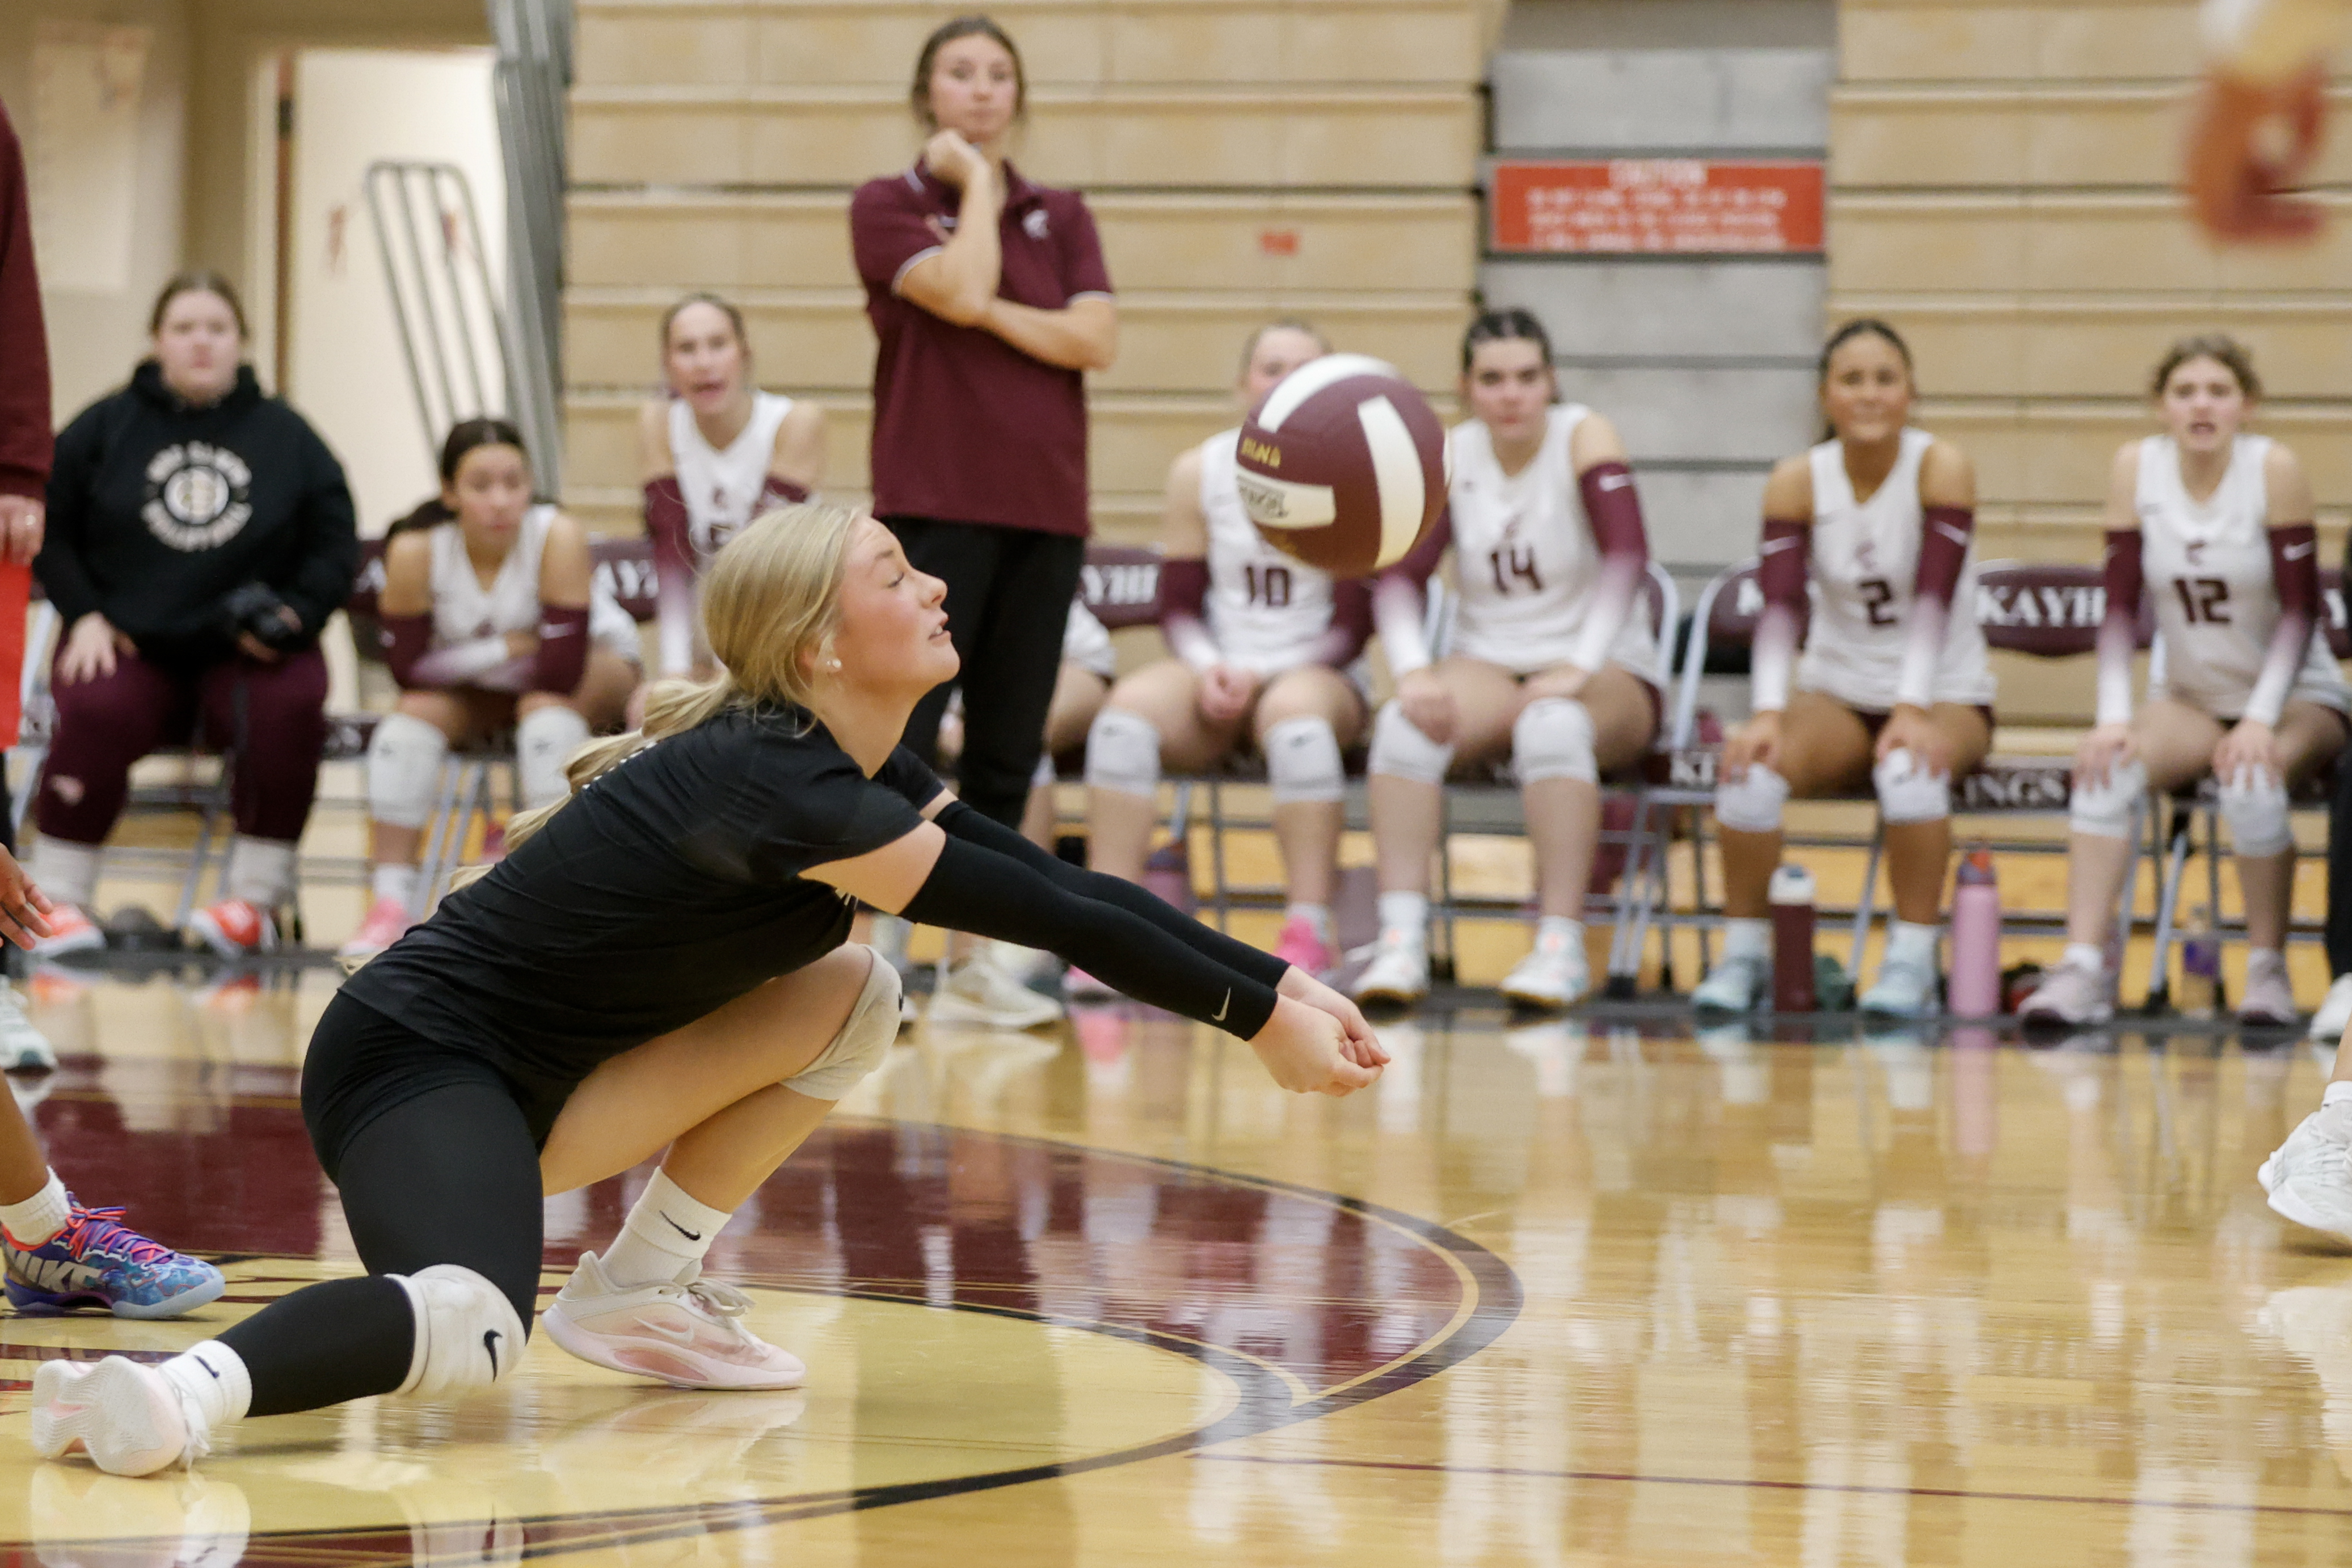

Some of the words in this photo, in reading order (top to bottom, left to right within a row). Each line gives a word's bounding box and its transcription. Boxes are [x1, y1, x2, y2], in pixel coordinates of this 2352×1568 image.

[1245, 564, 1289, 607] 10
[1490, 545, 1542, 591] 14
[1858, 579, 1897, 626] 2
[1976, 585, 2107, 627] KAYH
[2174, 579, 2232, 624] 12
